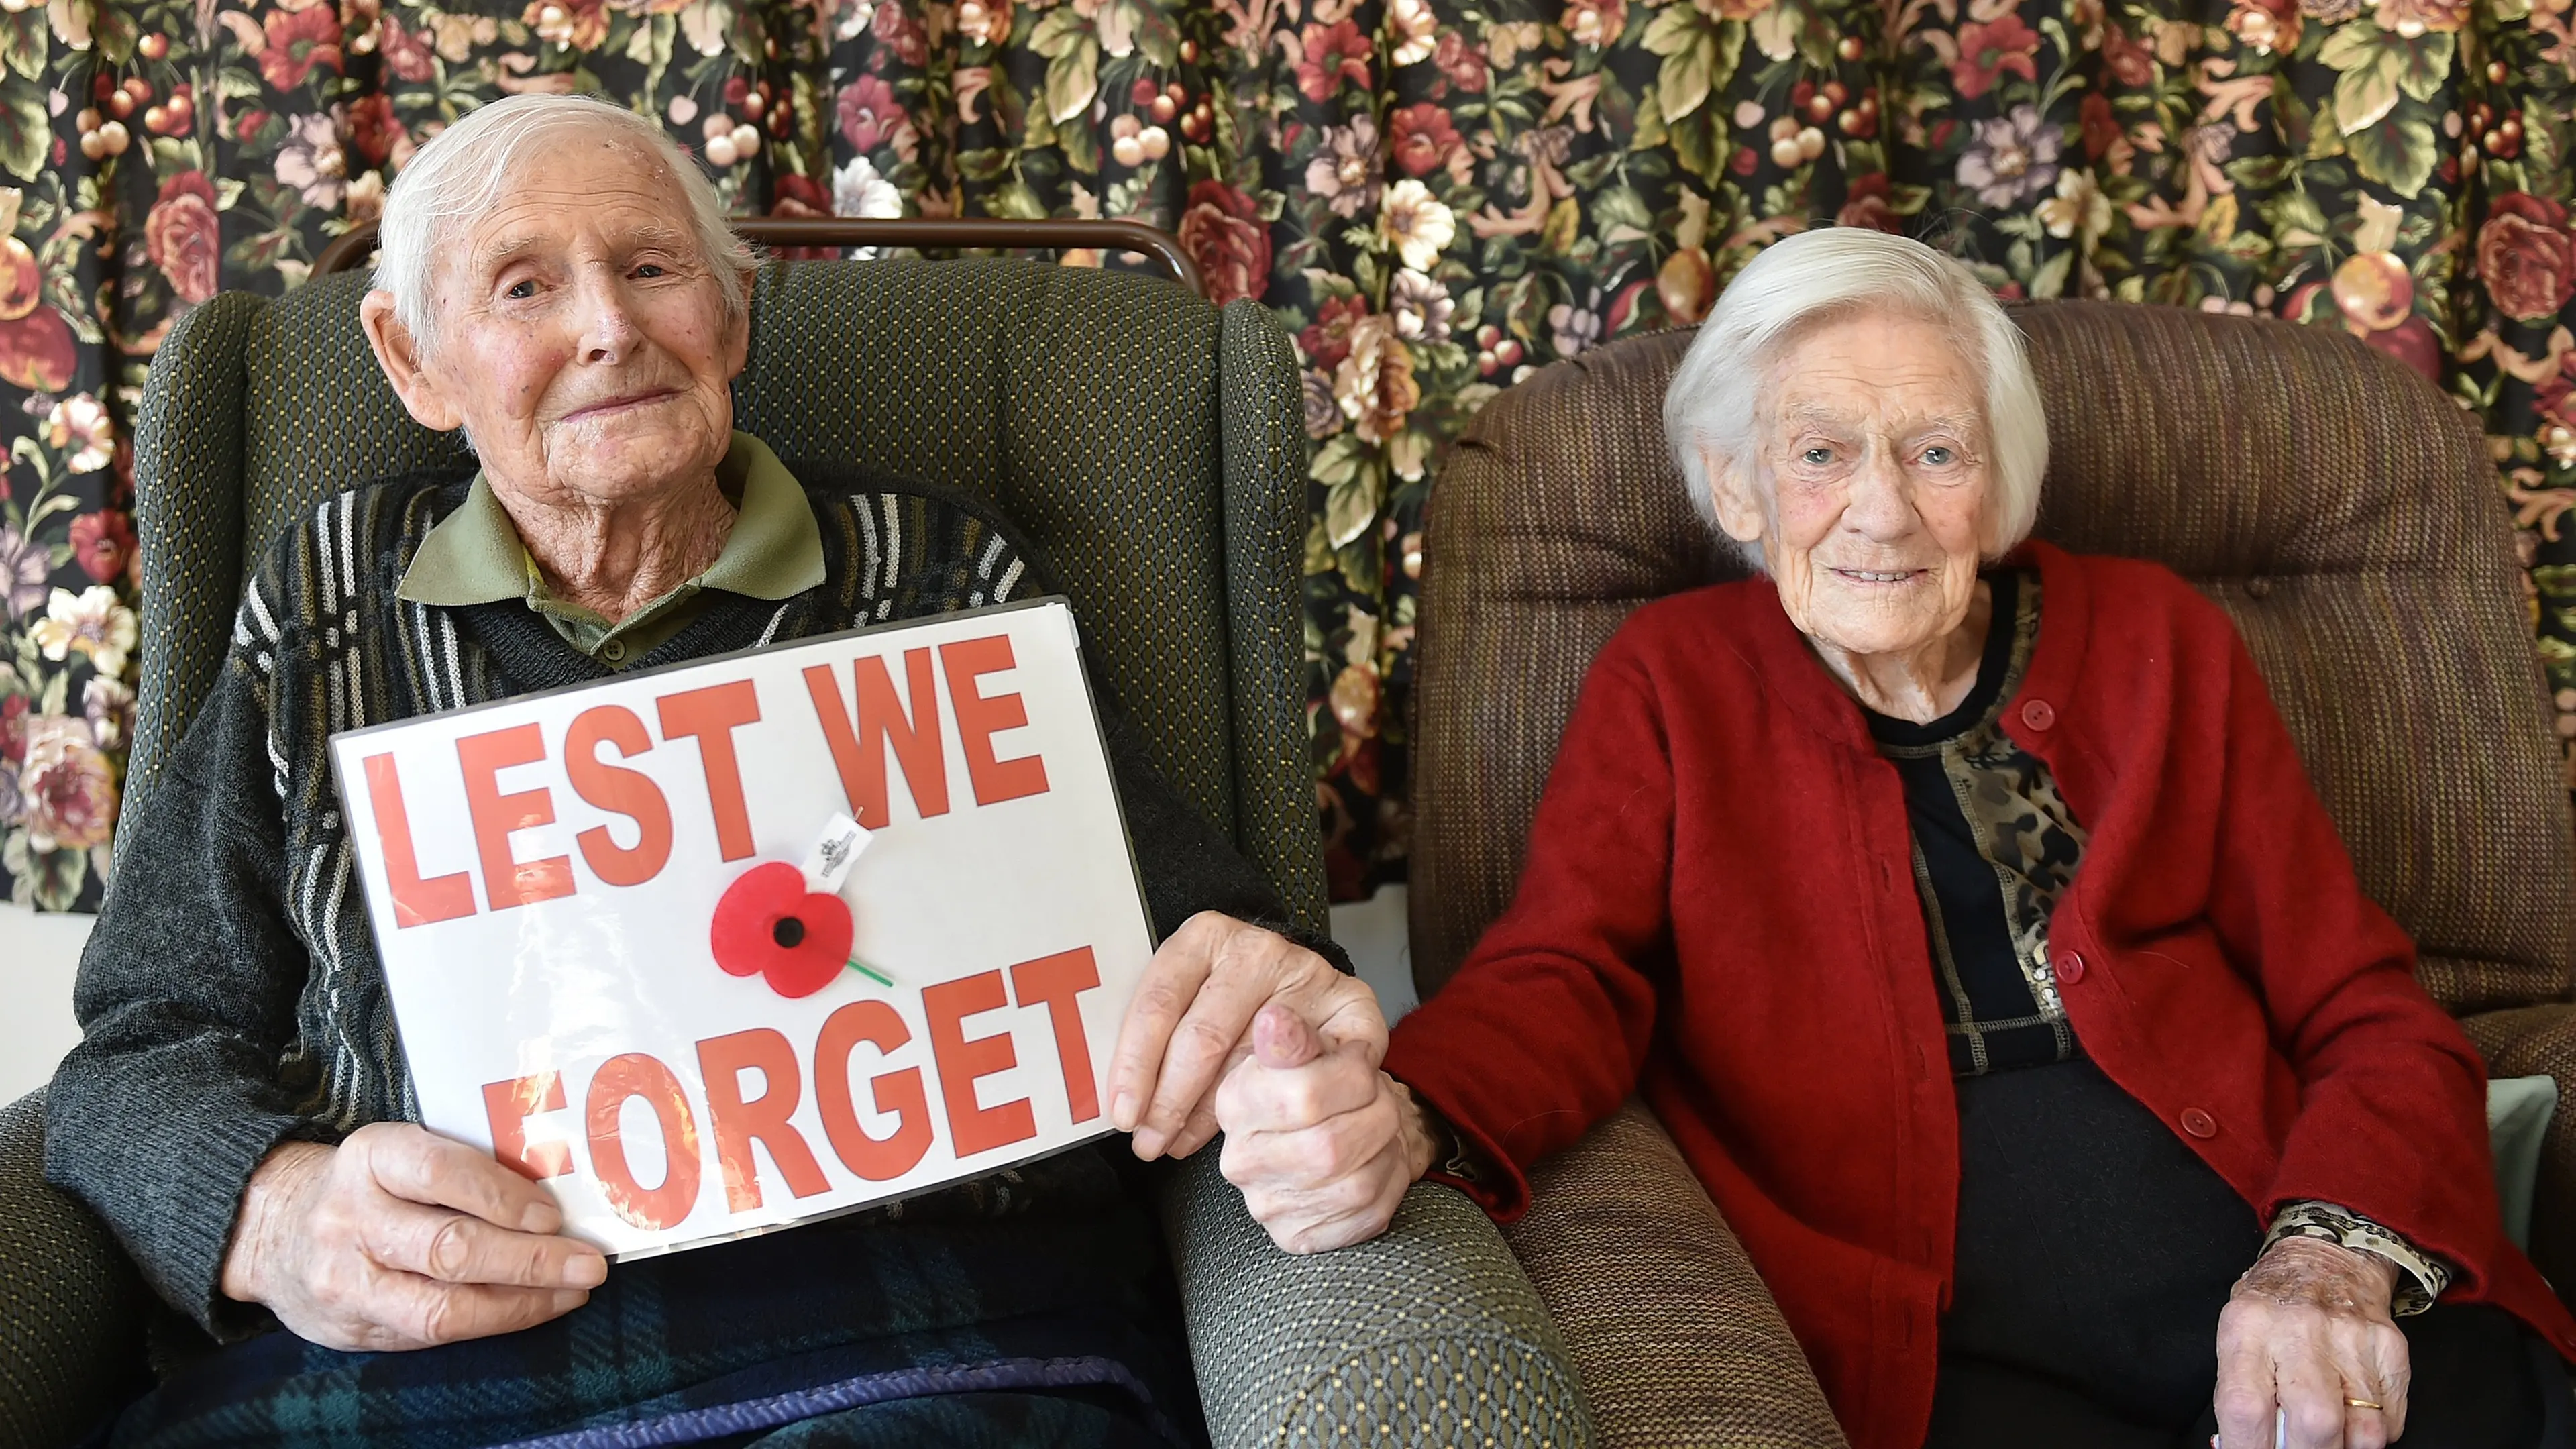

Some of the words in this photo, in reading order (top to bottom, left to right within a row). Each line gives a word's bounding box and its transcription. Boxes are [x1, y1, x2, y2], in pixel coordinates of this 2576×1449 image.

[364, 678, 761, 928] LEST
[804, 634, 1051, 830] WE
[481, 945, 1102, 1230] FORGET
